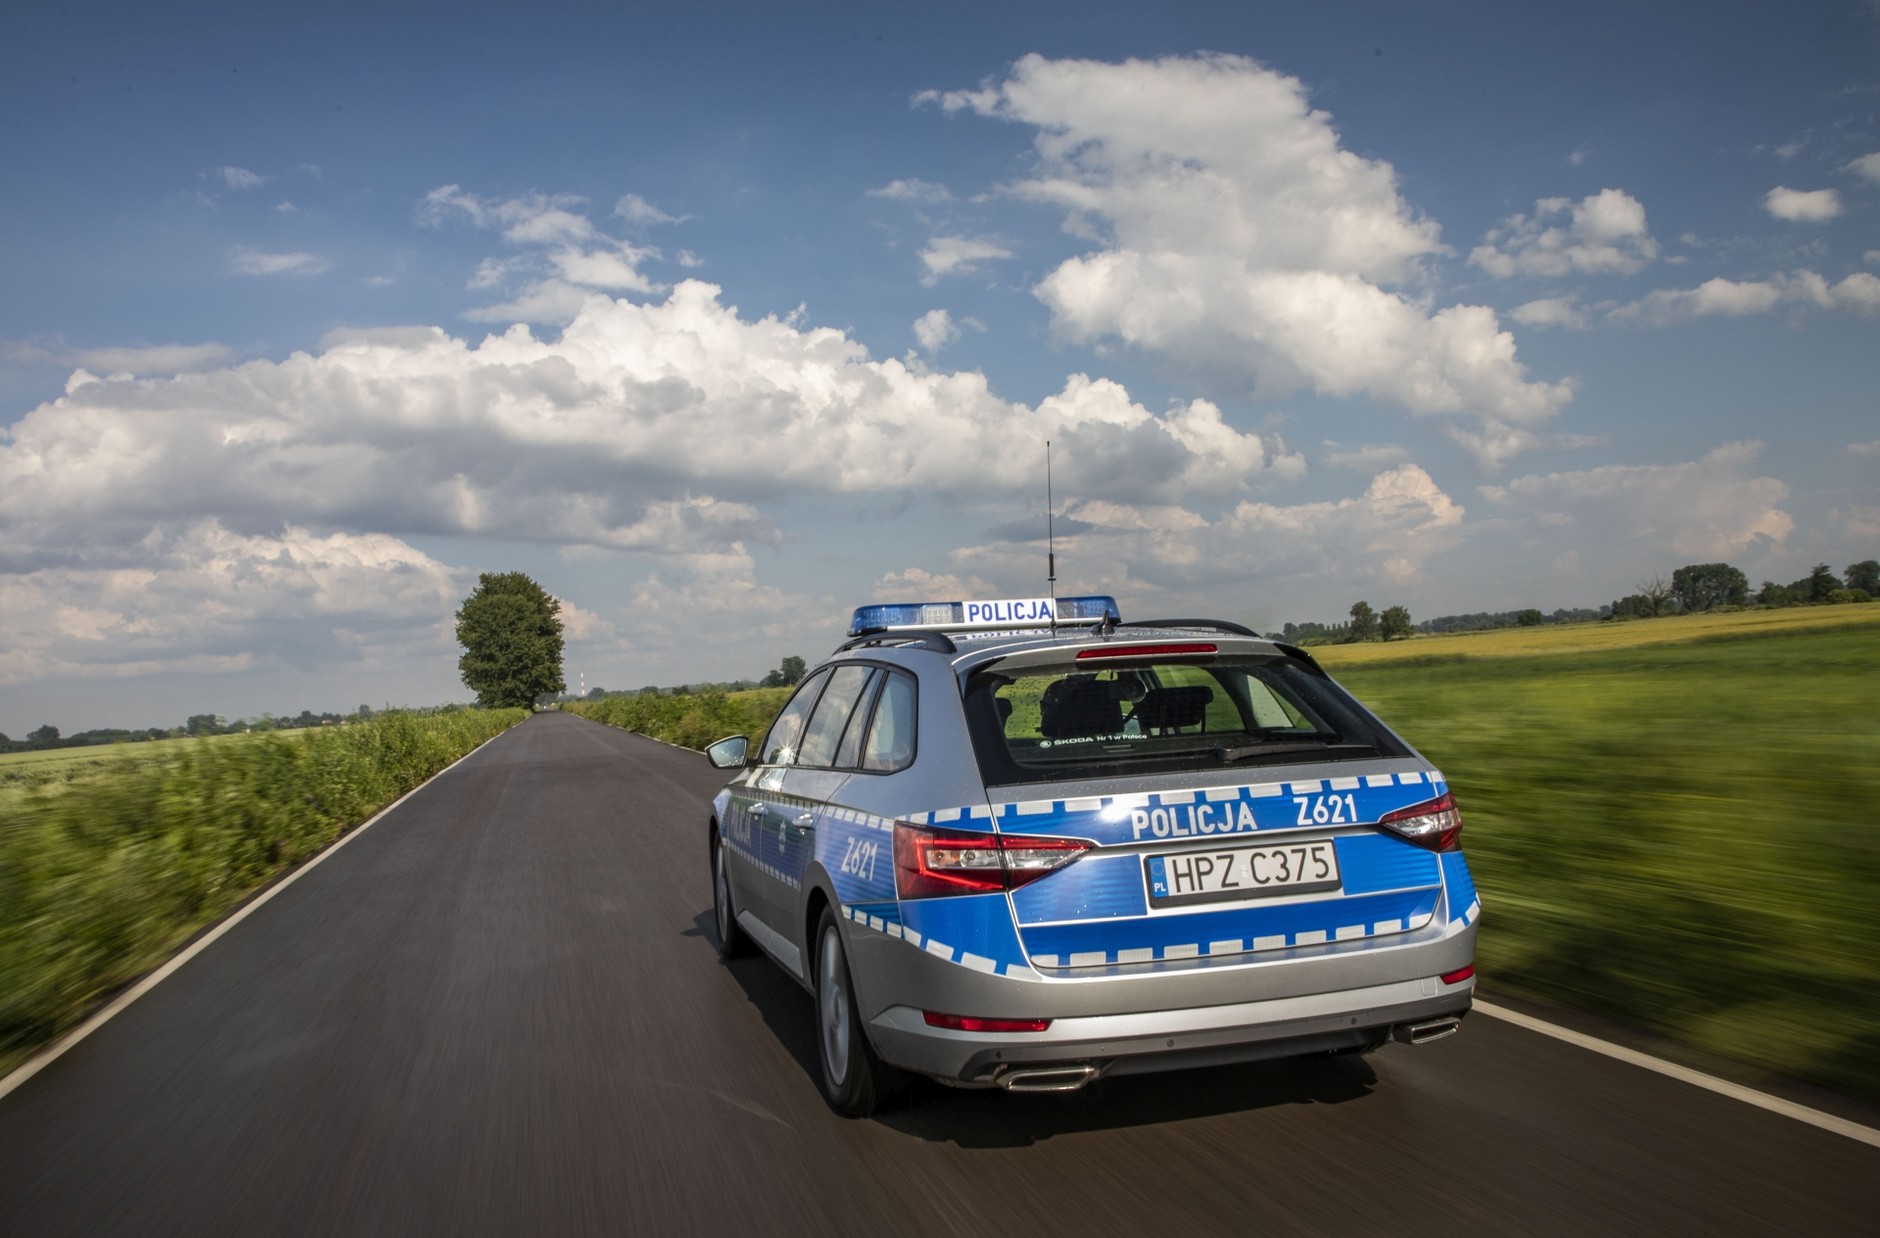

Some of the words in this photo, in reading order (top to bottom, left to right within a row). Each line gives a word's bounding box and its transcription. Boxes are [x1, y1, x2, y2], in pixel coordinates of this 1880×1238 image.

[968, 601, 1052, 622] POLICJA
[1122, 733, 1147, 741] Polsce
[1131, 801, 1258, 840] POLICJA
[1293, 793, 1358, 826] Z621
[841, 836, 878, 882] Z621
[1172, 854, 1239, 893] HPZ
[1249, 846, 1329, 885] C375
[1154, 882, 1167, 893] PL
